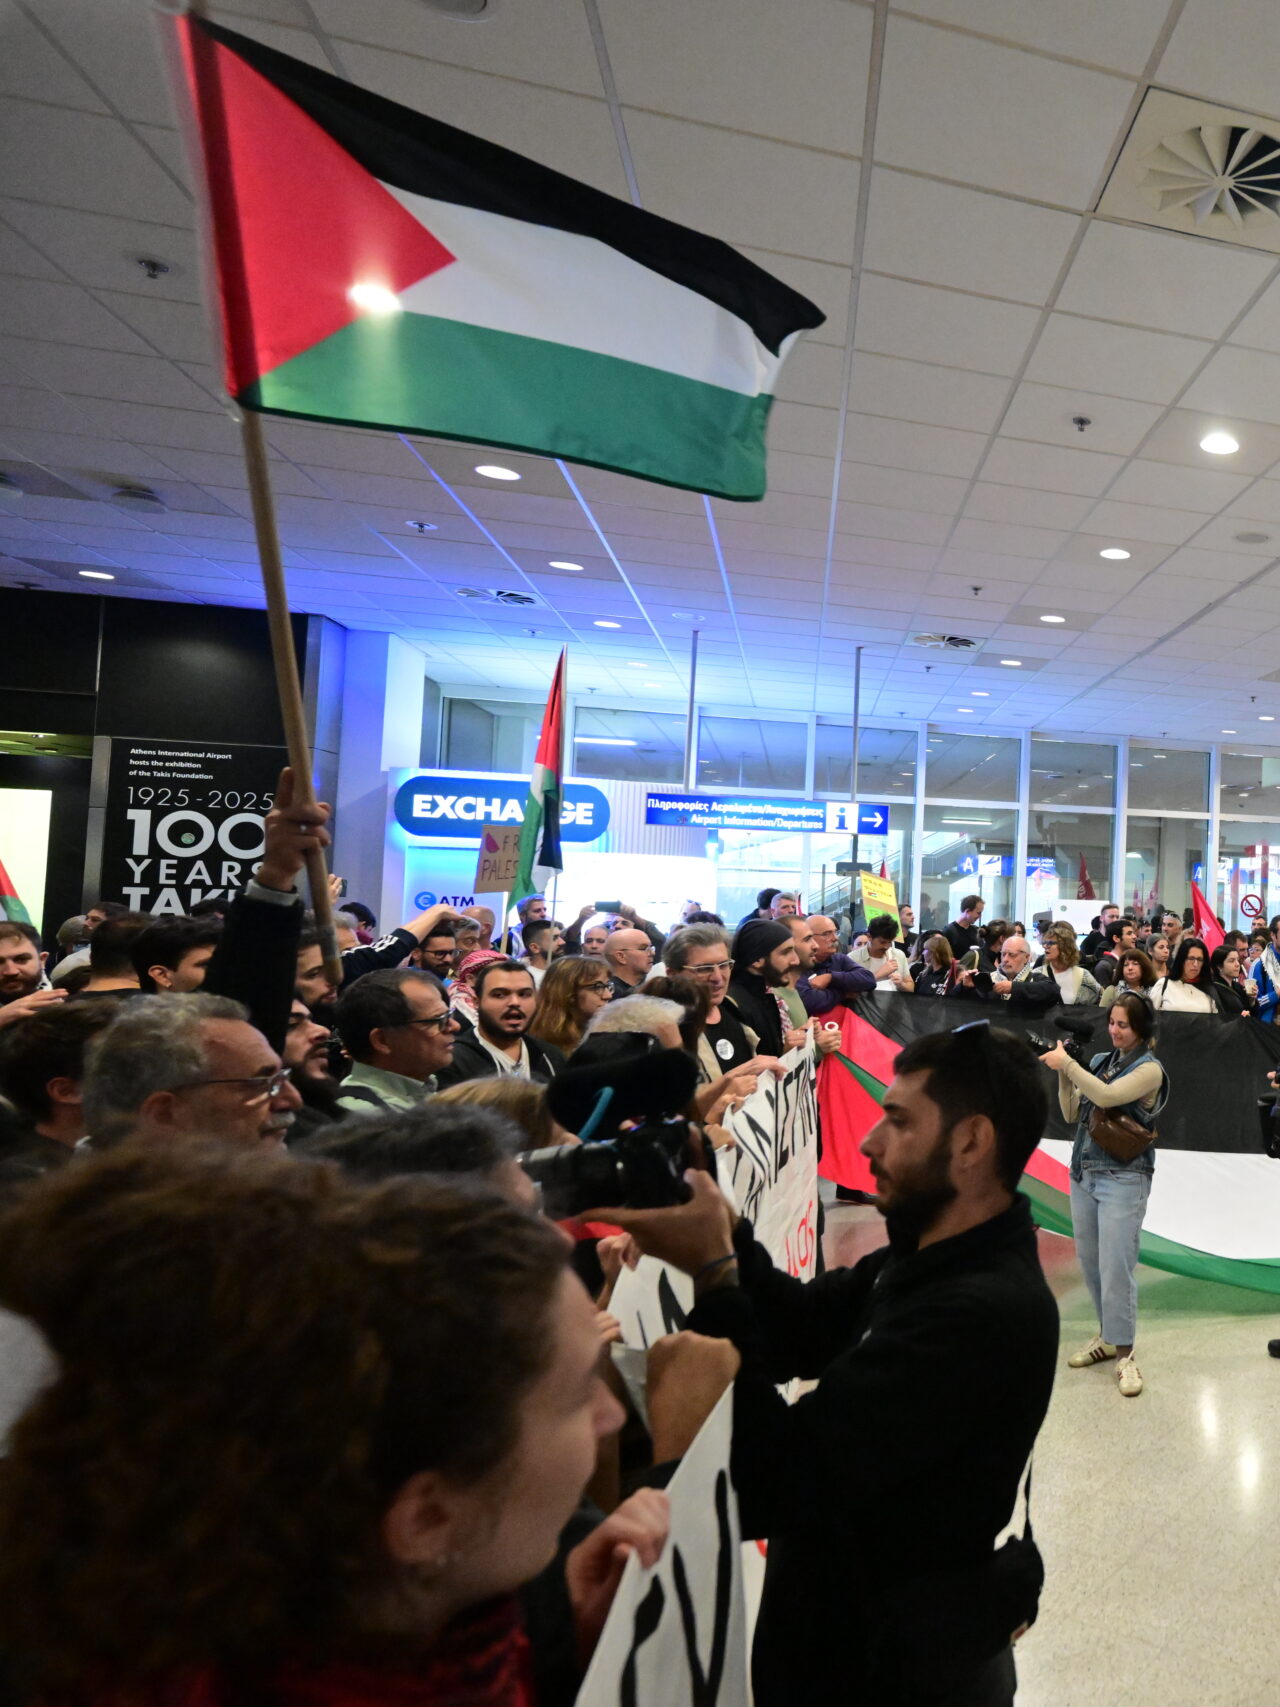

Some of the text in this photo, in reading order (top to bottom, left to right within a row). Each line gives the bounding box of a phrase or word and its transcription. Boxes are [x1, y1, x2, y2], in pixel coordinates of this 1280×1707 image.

[130, 748, 232, 760] Athens International Airport
[172, 772, 214, 780] Foundation
[412, 794, 594, 825] EXCHAGE
[648, 798, 708, 812] Πληροφορίες
[690, 813, 722, 825] Airport
[126, 809, 266, 860] 100
[502, 836, 520, 851] FR
[481, 860, 519, 881] PALES
[440, 896, 475, 907] ATM
